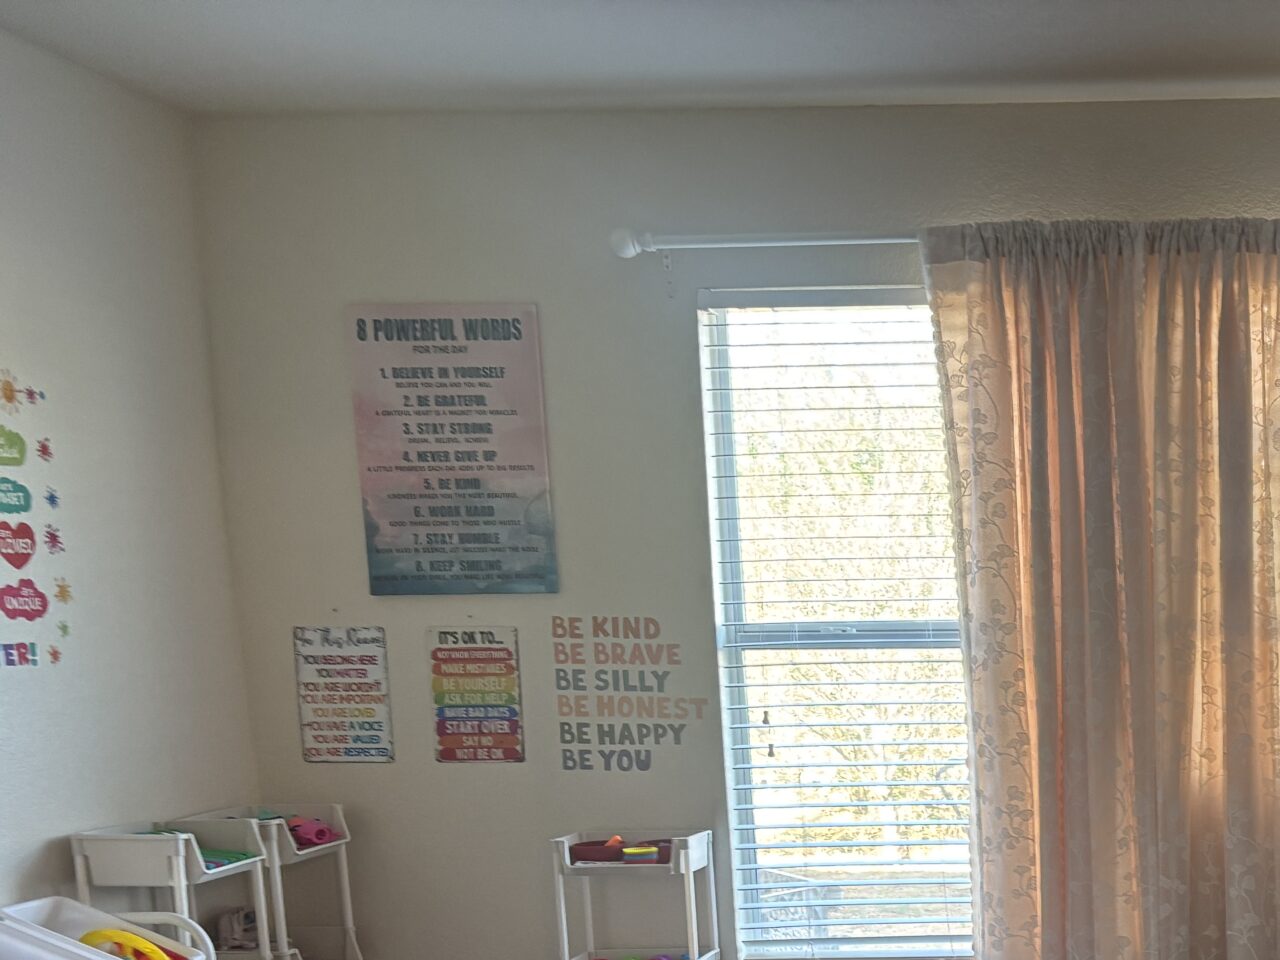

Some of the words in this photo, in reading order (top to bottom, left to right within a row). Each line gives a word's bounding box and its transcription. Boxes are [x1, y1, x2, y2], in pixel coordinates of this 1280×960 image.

[357, 318, 368, 341] 8
[372, 318, 457, 341] POWERFUL
[462, 317, 522, 341] WORDS
[392, 366, 434, 379] BELIEVE
[453, 366, 505, 379] YOURSELF
[416, 395, 430, 407] BE
[434, 395, 488, 407] GRATEFUL
[402, 422, 415, 434] 3.
[417, 422, 446, 434] STAY
[449, 422, 493, 434] STRONG
[402, 450, 414, 462] 4.
[417, 450, 451, 462] NEVER
[455, 450, 479, 462] GIVE
[482, 450, 497, 462] UP
[423, 478, 435, 490] 5.
[438, 478, 452, 490] BE
[454, 478, 481, 490] KIND
[428, 505, 461, 517] WORK
[465, 505, 495, 517] HARD
[426, 532, 453, 545] STAY
[428, 560, 455, 572] KEEP
[459, 559, 502, 572] SMILING
[4, 595, 43, 611] UNIQUE
[552, 616, 584, 638] BE
[592, 616, 660, 639] KIND
[438, 631, 459, 644] IT'S
[461, 631, 477, 644] OK
[553, 642, 586, 664] BE
[594, 642, 682, 665] BRAVE
[441, 663, 466, 674] MAKE
[443, 678, 457, 690] BE
[458, 678, 505, 690] YOURSELF
[555, 669, 587, 690] BE
[594, 670, 671, 692] SILLY
[444, 693, 463, 704] ASK
[464, 693, 483, 704] FOR
[484, 693, 508, 704] HELP
[349, 708, 376, 718] LOVED
[557, 695, 589, 717] BE
[597, 696, 708, 719] HONEST
[356, 721, 384, 731] VOICE
[446, 721, 479, 733] START
[481, 720, 510, 733] OVER
[559, 722, 592, 744] BE
[597, 723, 687, 744] HAPPY
[463, 736, 479, 746] SAY
[562, 749, 594, 770] BE
[598, 749, 652, 771] YOU
